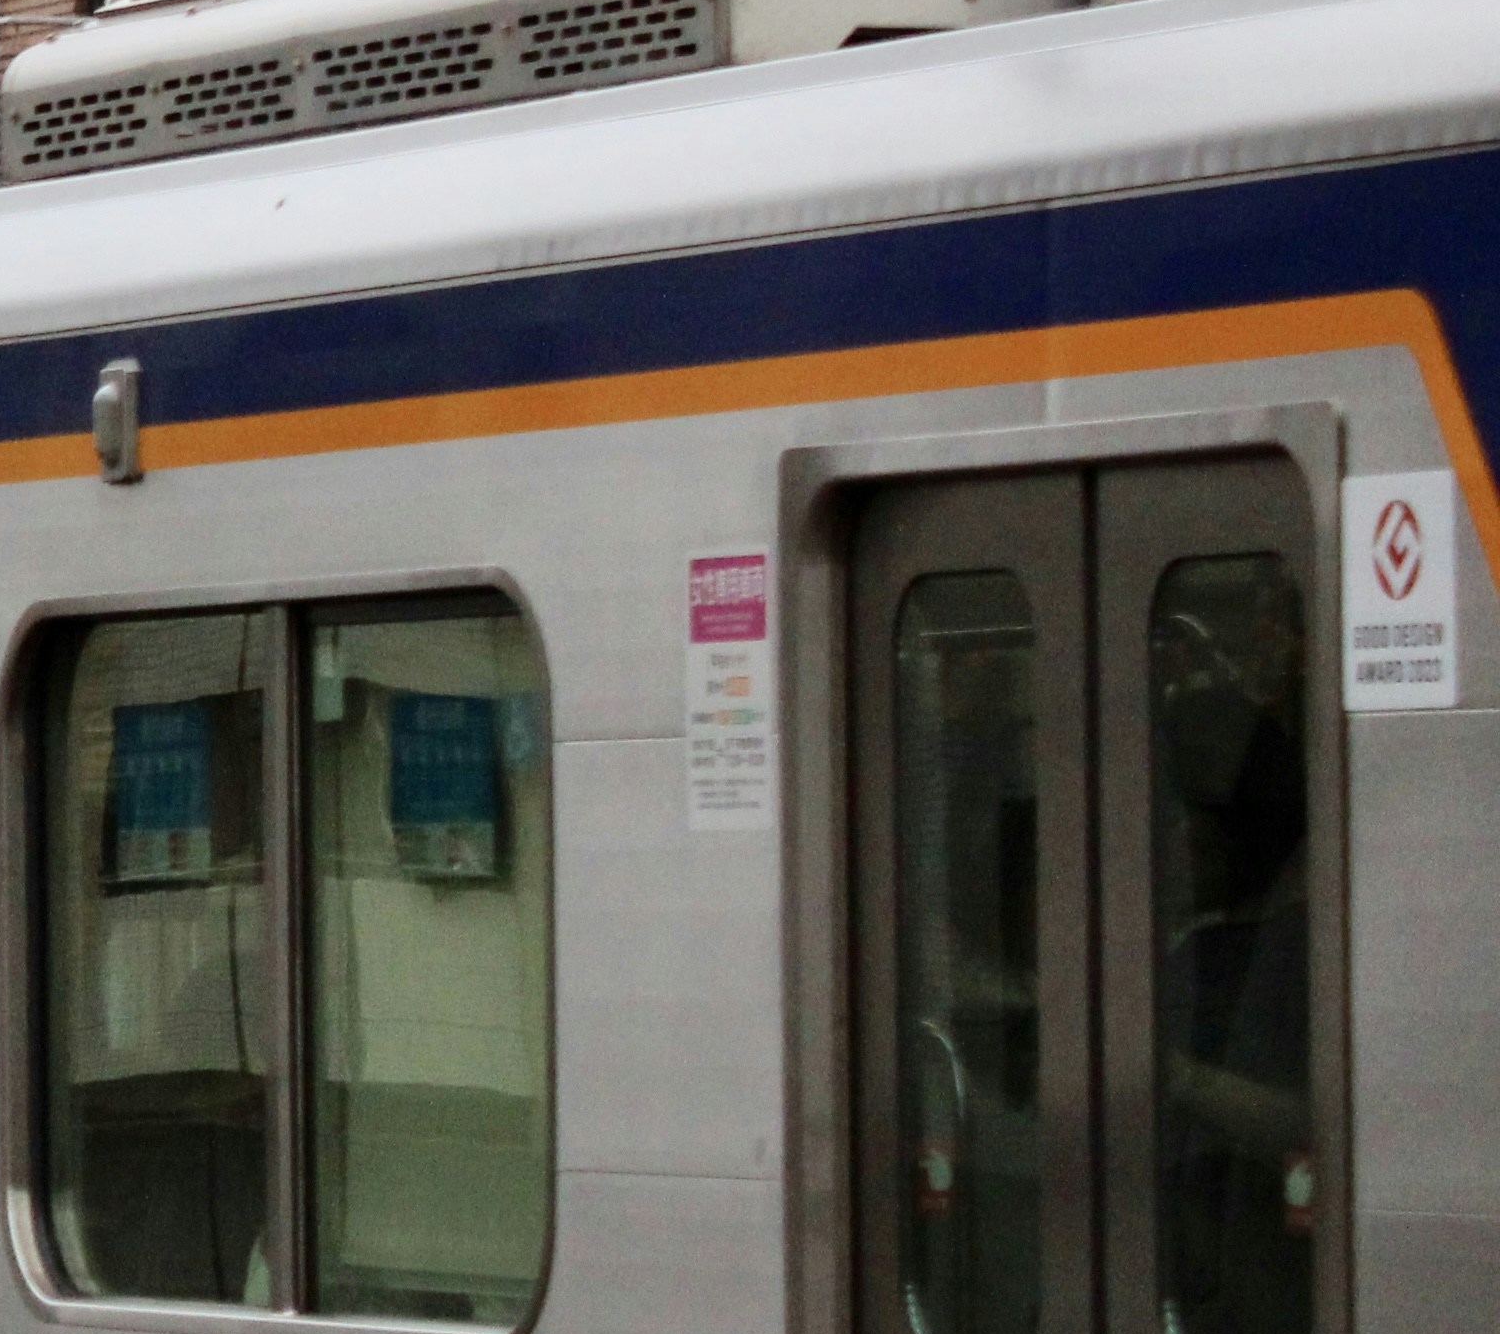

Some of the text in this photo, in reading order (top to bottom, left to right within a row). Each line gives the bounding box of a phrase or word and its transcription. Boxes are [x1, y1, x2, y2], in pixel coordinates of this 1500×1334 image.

[1353, 622, 1444, 649] GOOD DESIGN
[1356, 659, 1403, 685] AWARD
